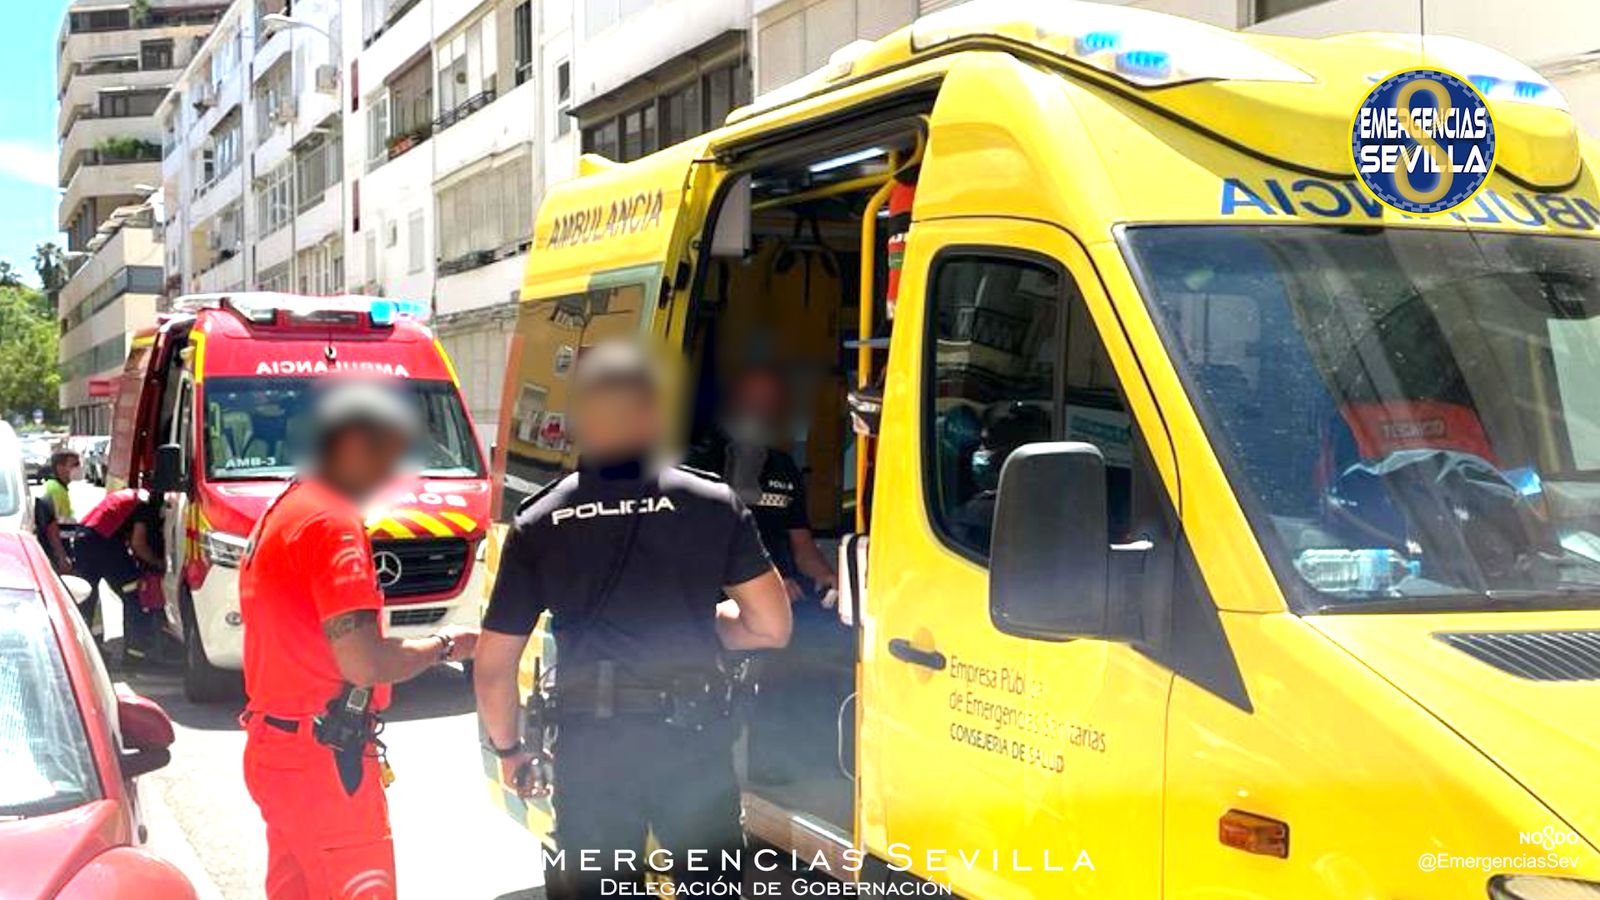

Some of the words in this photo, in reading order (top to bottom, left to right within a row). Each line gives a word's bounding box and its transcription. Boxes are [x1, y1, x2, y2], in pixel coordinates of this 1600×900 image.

[547, 188, 662, 249] AMBULANCIA
[551, 496, 675, 526] POLICIA
[950, 655, 997, 689] Empresa
[1000, 666, 1044, 699] Públa
[949, 690, 963, 712] de
[966, 691, 1040, 734] Emergencas
[1043, 712, 1106, 753] Satarias
[1011, 741, 1026, 762] DE
